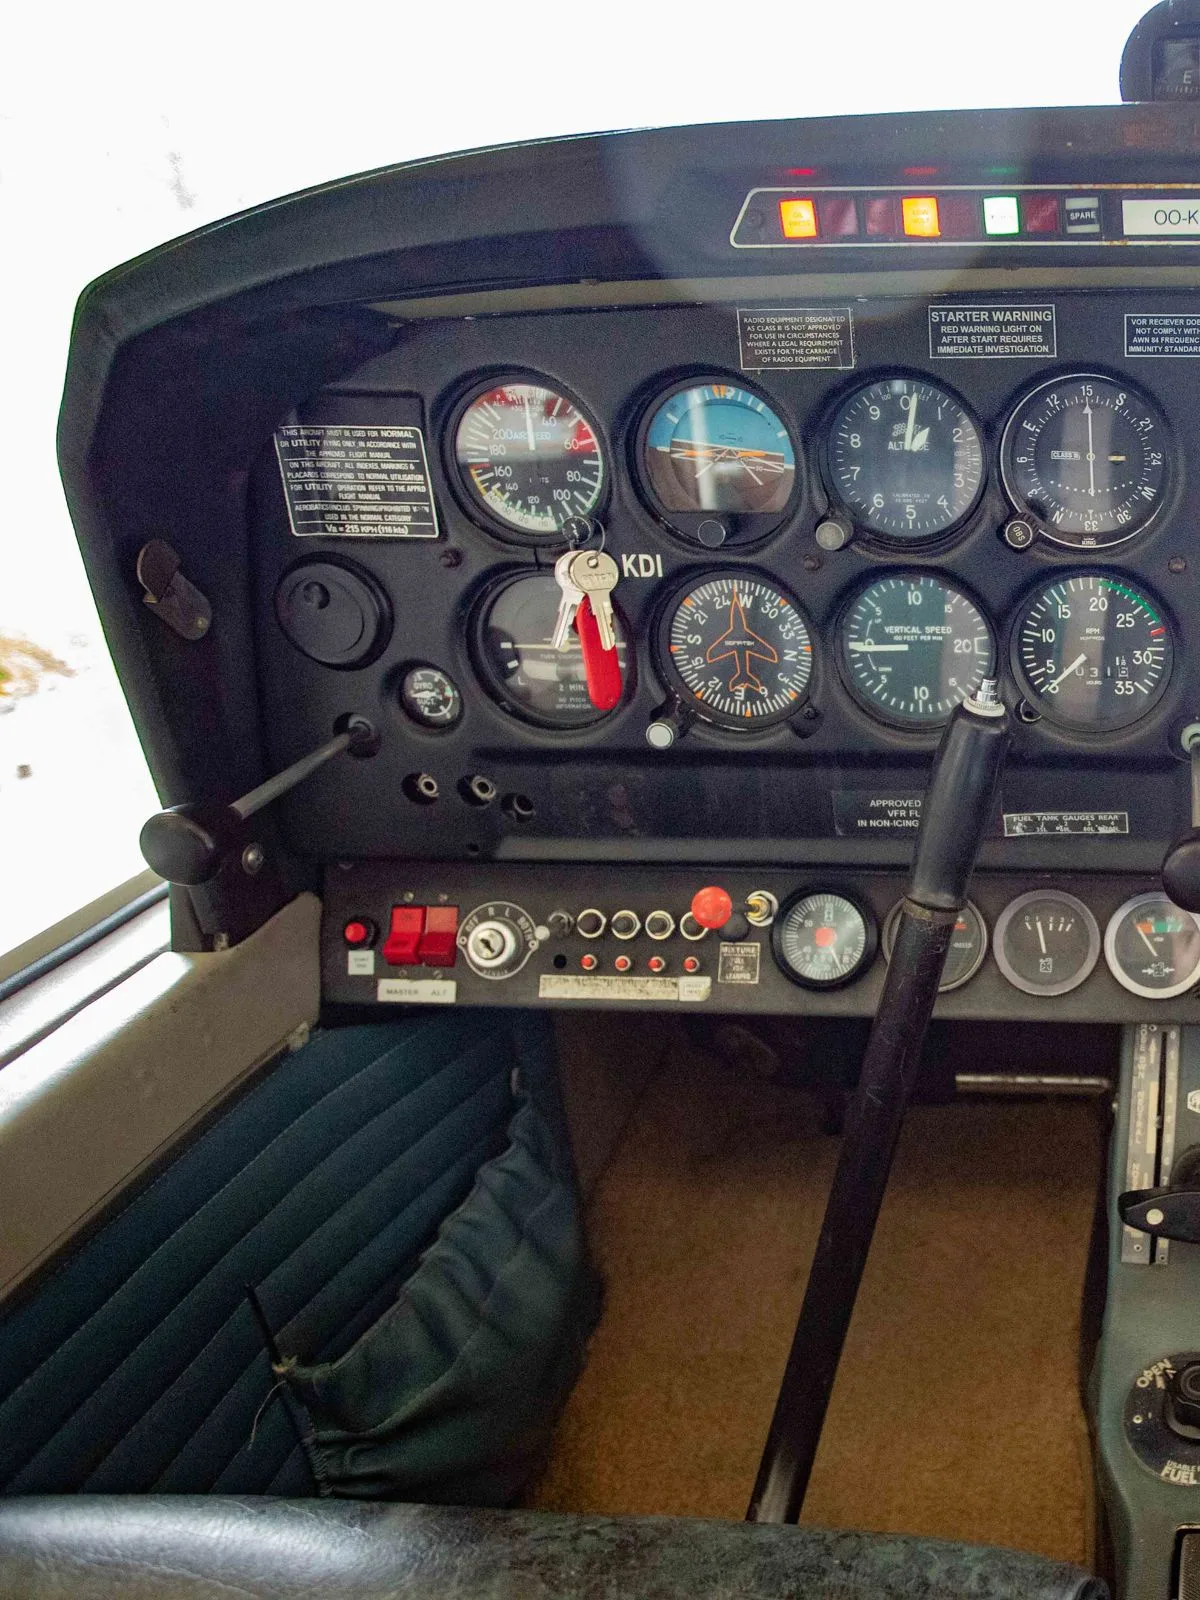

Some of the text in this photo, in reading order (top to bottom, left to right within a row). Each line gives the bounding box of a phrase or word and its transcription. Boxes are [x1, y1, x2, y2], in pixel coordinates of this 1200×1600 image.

[1183, 70, 1193, 84] E
[1070, 210, 1097, 220] SPARE
[931, 311, 1052, 322] STARTER WARNING
[960, 325, 1000, 333] WARNING
[1002, 325, 1027, 333] LIGHT
[1000, 335, 1043, 343] REQUIRES
[937, 345, 1048, 354] IMMEDIATE INVESTIGATION
[900, 395, 911, 411] 0
[869, 405, 880, 420] 9
[542, 416, 557, 426] 40
[380, 430, 414, 438] NORMAL
[492, 428, 513, 440] 200
[952, 428, 963, 442] 2
[564, 439, 579, 449] 60
[850, 433, 861, 448] 8
[489, 444, 506, 455] 180
[494, 466, 513, 477] 160
[566, 471, 581, 482] 80
[850, 466, 861, 480] 7
[953, 473, 965, 488] 3
[505, 483, 519, 491] 140
[527, 496, 540, 504] 120
[553, 489, 571, 500] 100
[873, 493, 884, 508] 6
[937, 495, 949, 508] 4
[905, 505, 916, 519] 5
[622, 554, 663, 577] KDI
[713, 595, 731, 609] 24
[738, 593, 753, 608] W
[1089, 597, 1108, 611] 20
[1058, 604, 1071, 618] 15
[1116, 613, 1135, 627] 25
[884, 625, 952, 634] VERTICAL SPEED
[1042, 629, 1055, 643] 10
[784, 650, 798, 661] N
[1132, 651, 1152, 664] 30
[1046, 661, 1055, 673] 5
[414, 681, 432, 689] GYRO
[1114, 681, 1134, 695] 35
[869, 800, 921, 808] APPROVED
[887, 809, 907, 817] VFR
[857, 819, 919, 827] IN NON-ICING
[488, 907, 495, 916] R
[504, 907, 510, 916] L
[465, 918, 479, 932] OFF
[517, 916, 535, 941] BOTH
[722, 946, 756, 954] MIXTURE
[1136, 1358, 1173, 1388] OPEN
[1160, 1464, 1198, 1484] FUEL
